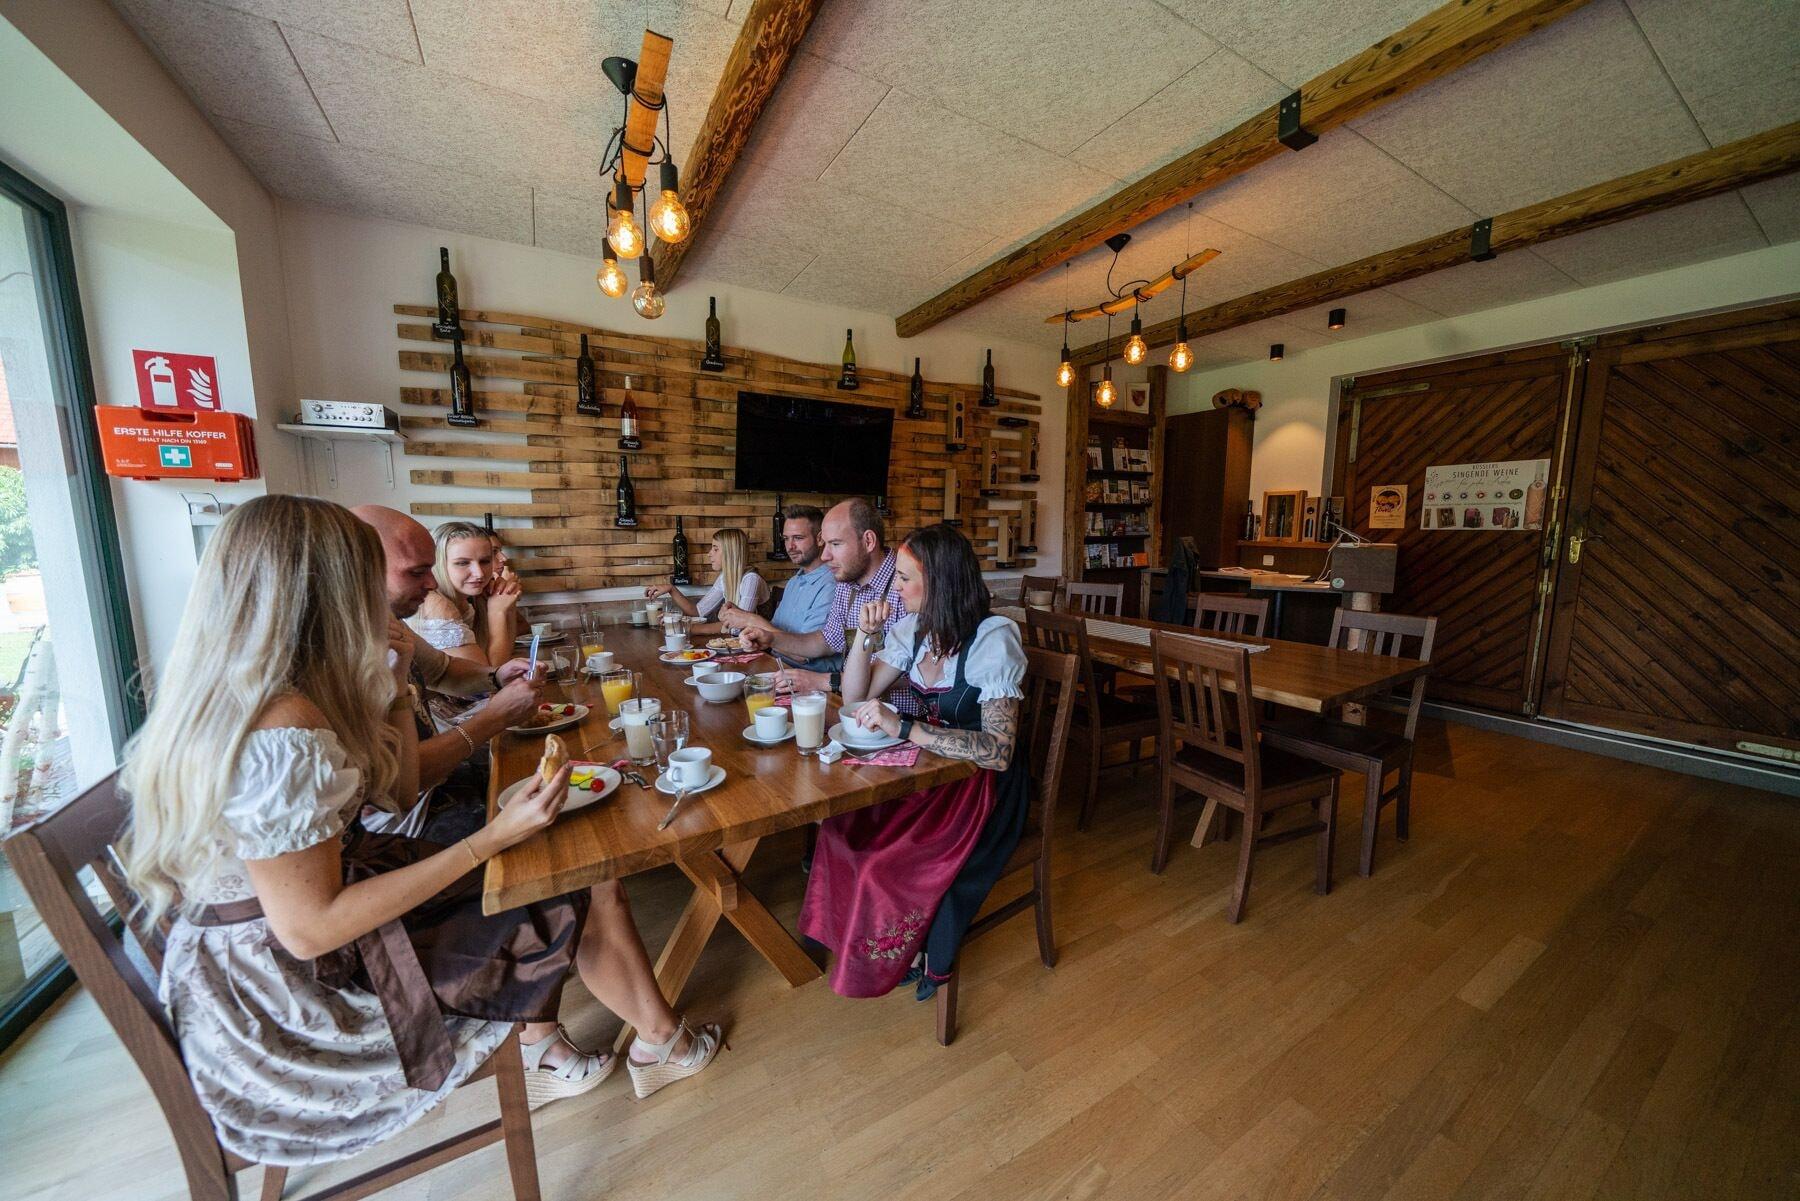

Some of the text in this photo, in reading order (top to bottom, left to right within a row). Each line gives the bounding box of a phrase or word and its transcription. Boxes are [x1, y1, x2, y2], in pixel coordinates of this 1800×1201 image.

[113, 427, 226, 439] ERSTE HILFE KOFFER
[1452, 468, 1519, 479] SINGENDE WEINE
